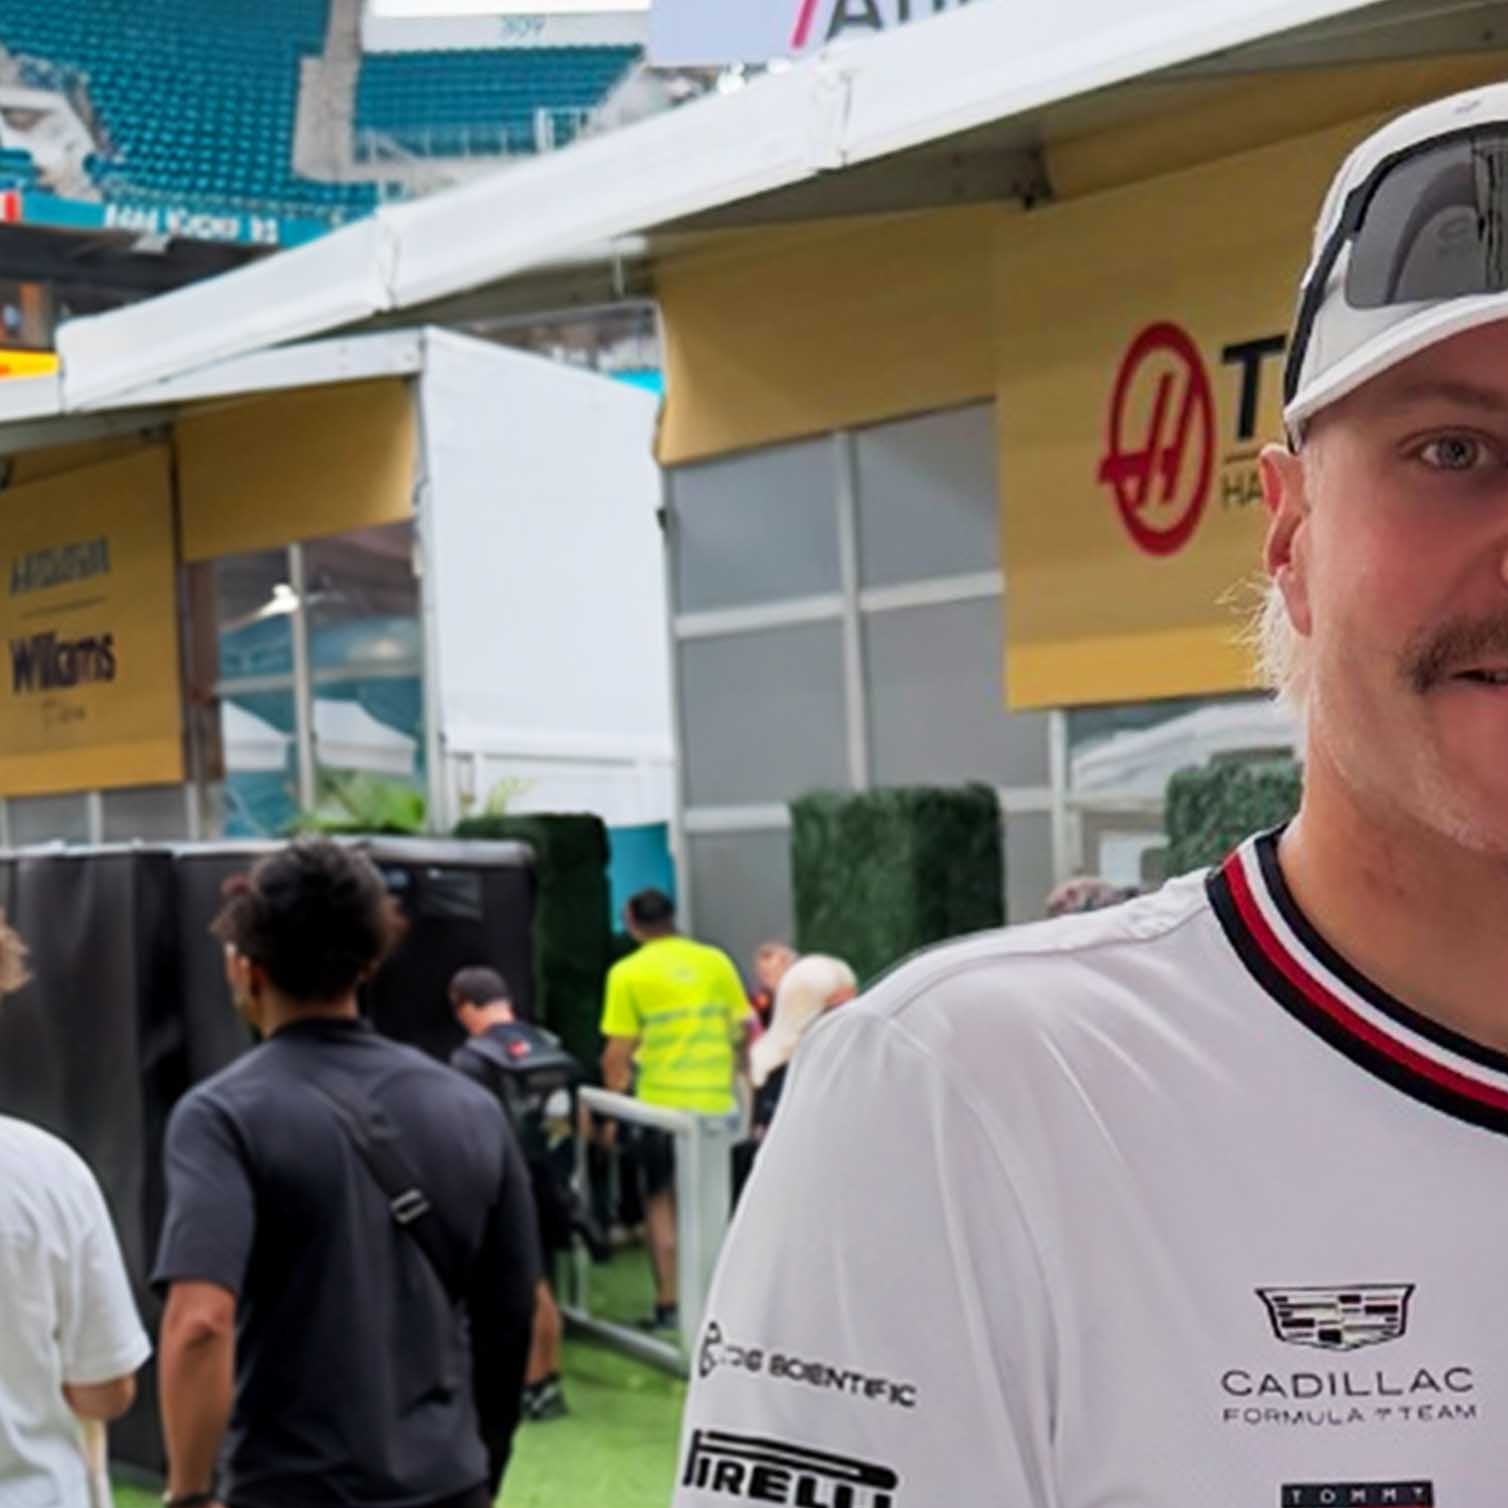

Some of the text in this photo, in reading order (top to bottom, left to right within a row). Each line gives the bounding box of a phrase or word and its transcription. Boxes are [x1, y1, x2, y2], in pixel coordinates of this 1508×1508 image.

[1221, 1366, 1475, 1399] CADILLAC
[1223, 1407, 1365, 1426] FORMULA
[1398, 1405, 1478, 1422] TEAM
[1292, 1487, 1425, 1504] TOMMY
